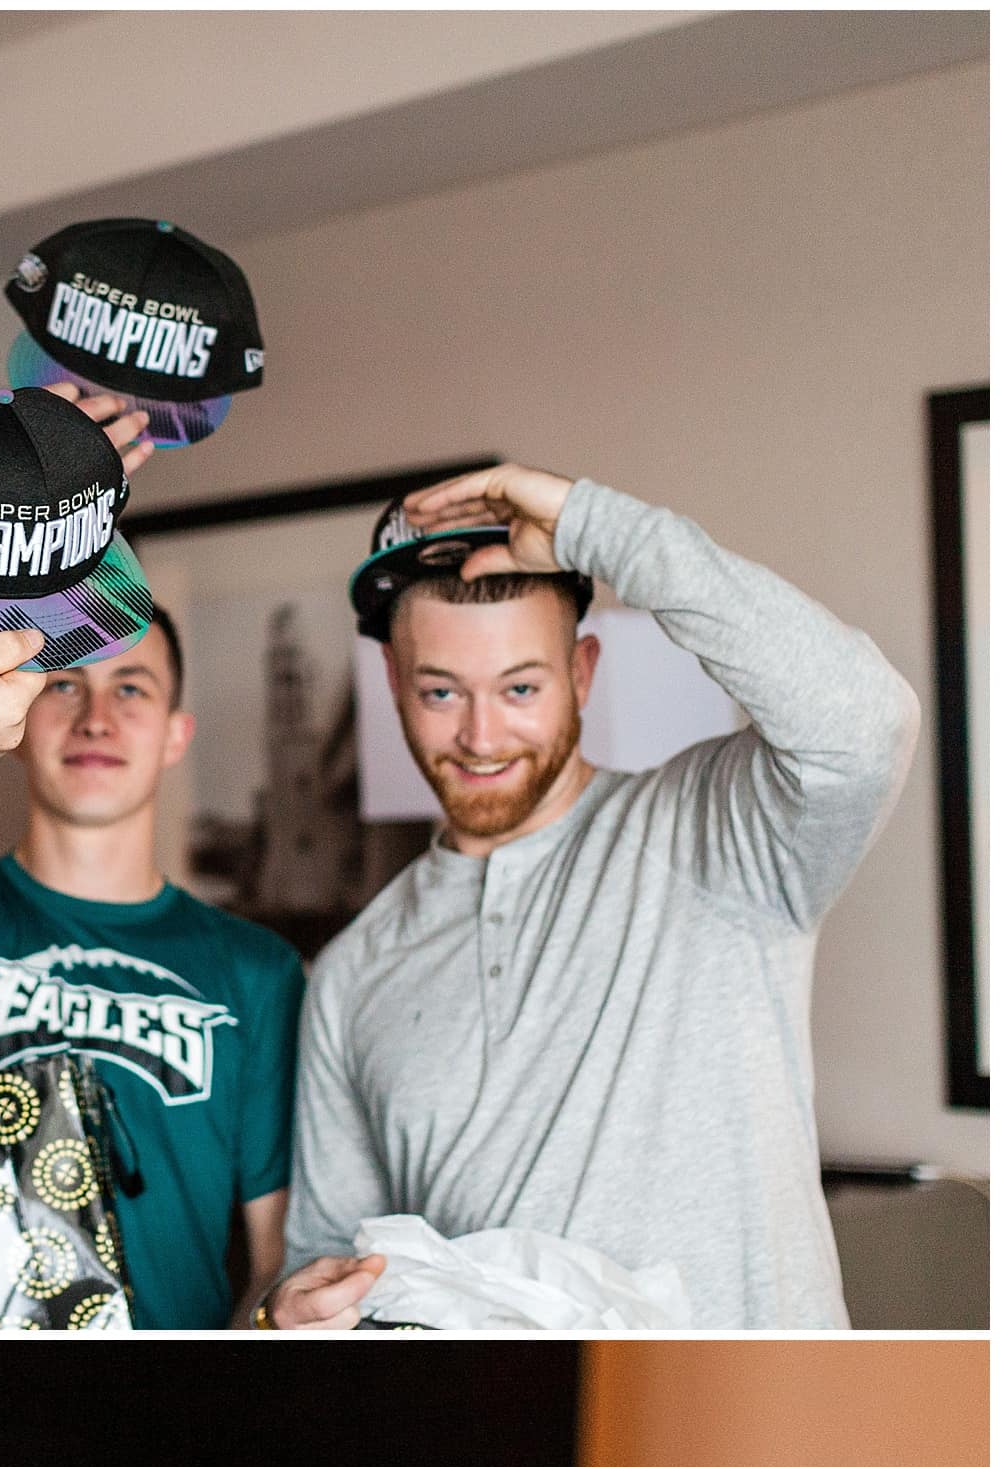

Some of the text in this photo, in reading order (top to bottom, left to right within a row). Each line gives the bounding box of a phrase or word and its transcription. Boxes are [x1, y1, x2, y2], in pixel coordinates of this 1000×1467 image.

[71, 272, 204, 325] SUPER BOWL
[47, 281, 218, 378] CHAMPIONS
[58, 482, 104, 517] BOWL
